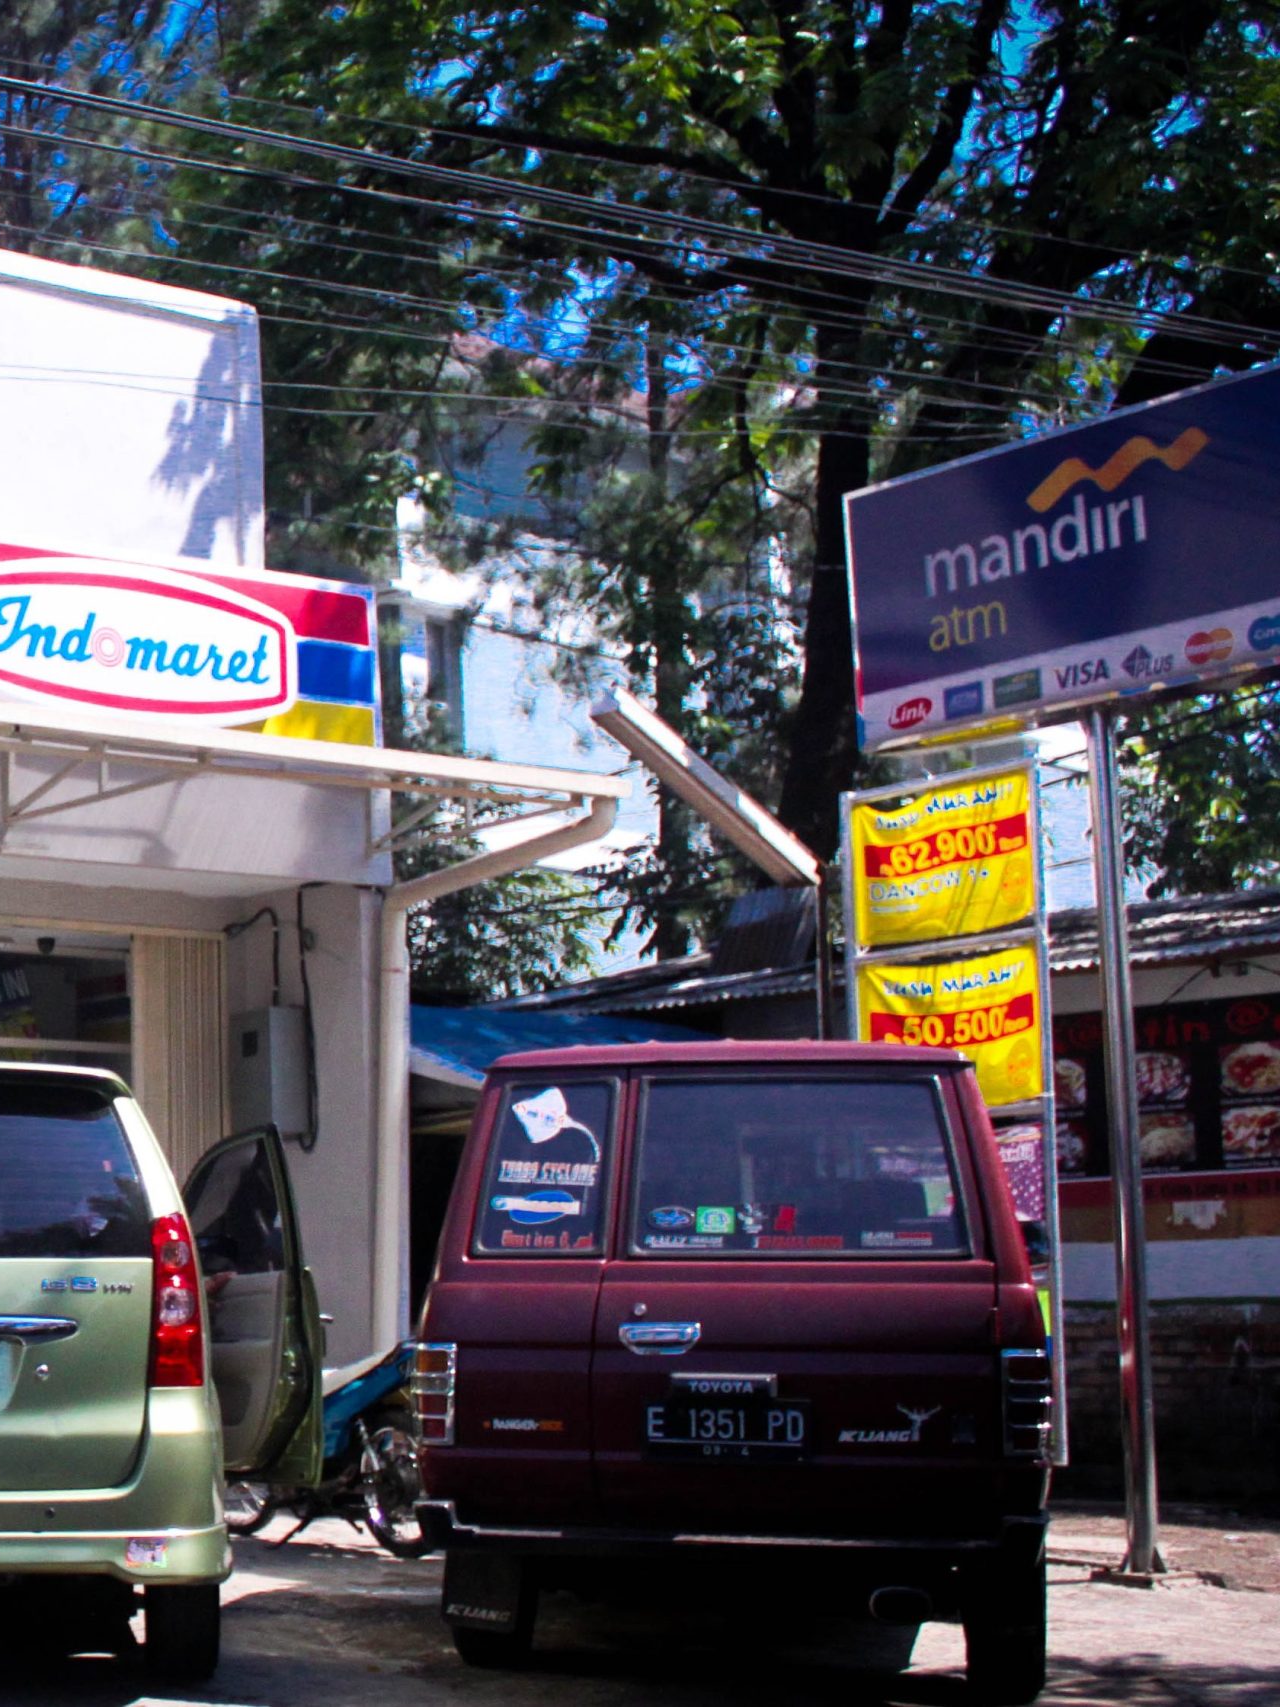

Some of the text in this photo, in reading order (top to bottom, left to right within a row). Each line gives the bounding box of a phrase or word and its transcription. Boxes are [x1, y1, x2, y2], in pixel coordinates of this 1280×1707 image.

[924, 494, 1147, 597] mandiri
[929, 600, 1007, 652] atm
[1055, 658, 1109, 689] VISA
[689, 1380, 754, 1395] TOYOTA
[646, 1405, 805, 1442] E 1351 PD
[837, 1428, 912, 1443] KIJANG
